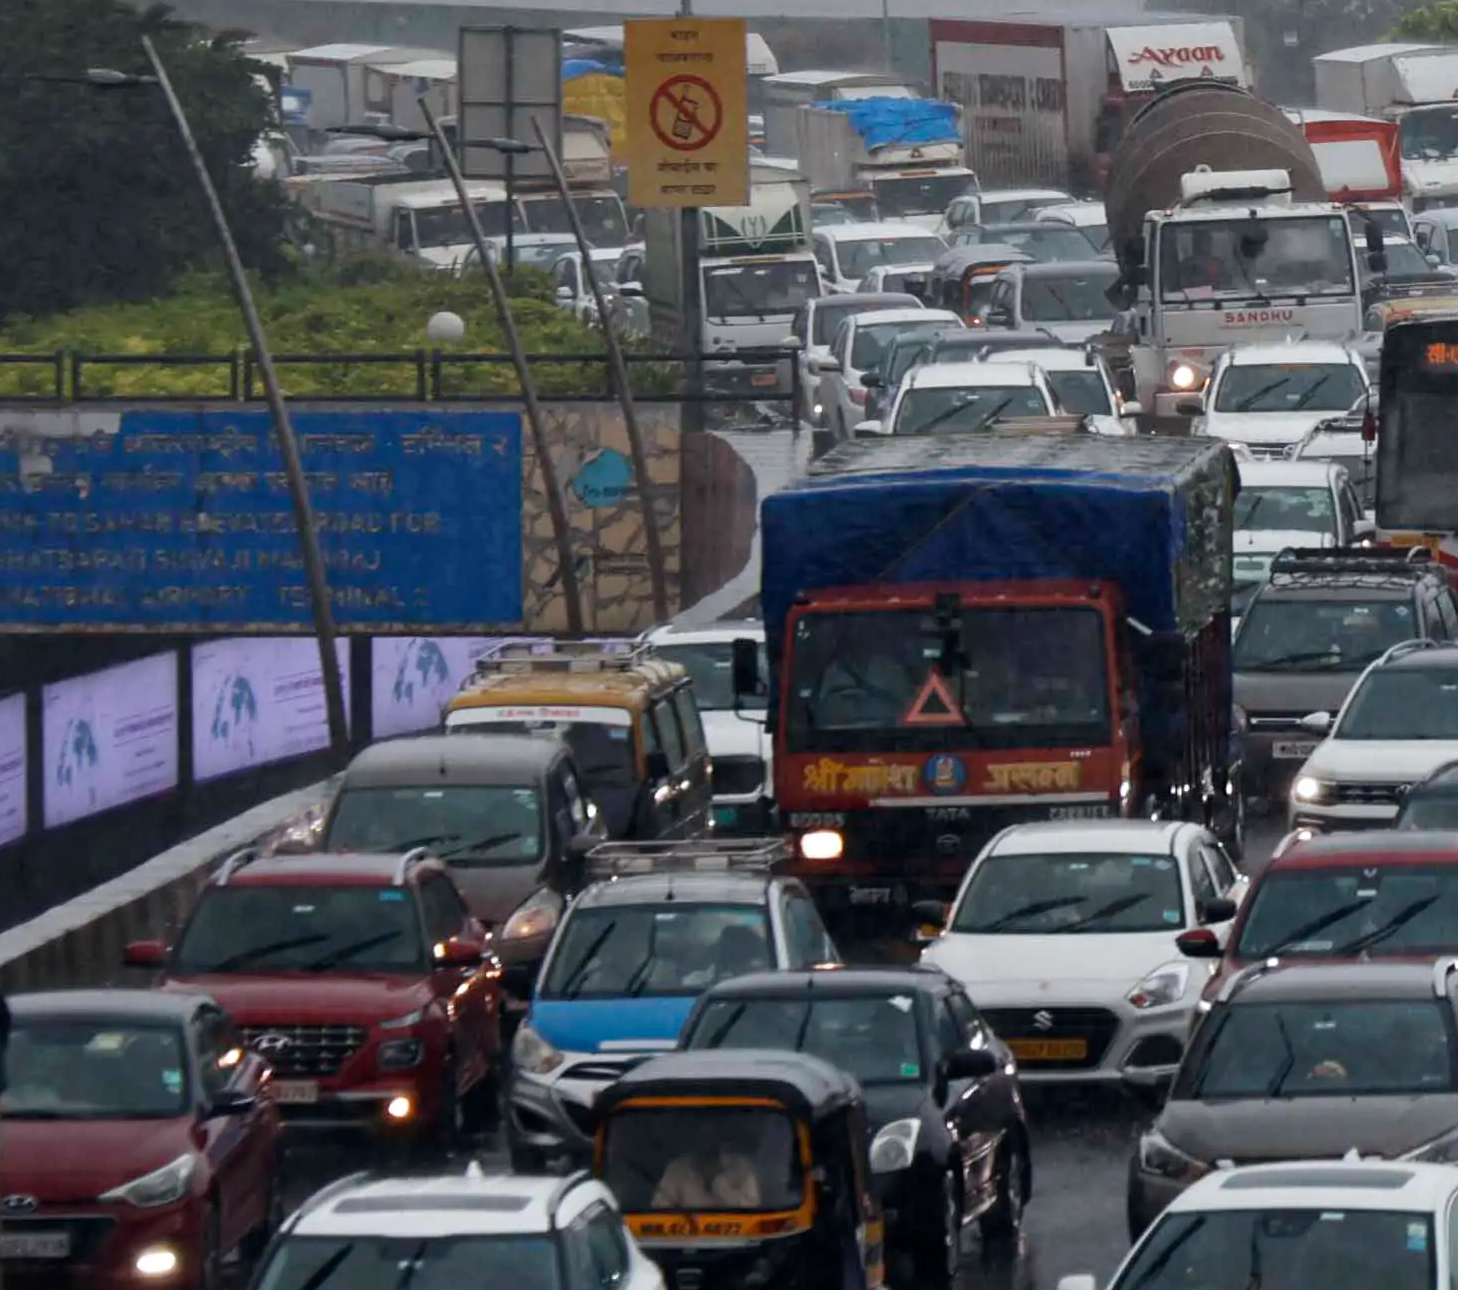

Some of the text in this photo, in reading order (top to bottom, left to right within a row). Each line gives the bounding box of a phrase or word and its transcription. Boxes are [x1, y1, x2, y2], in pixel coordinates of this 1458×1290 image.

[1128, 46, 1228, 66] Ayaan
[1225, 310, 1294, 324] SANDHU
[925, 807, 970, 821] TATA
